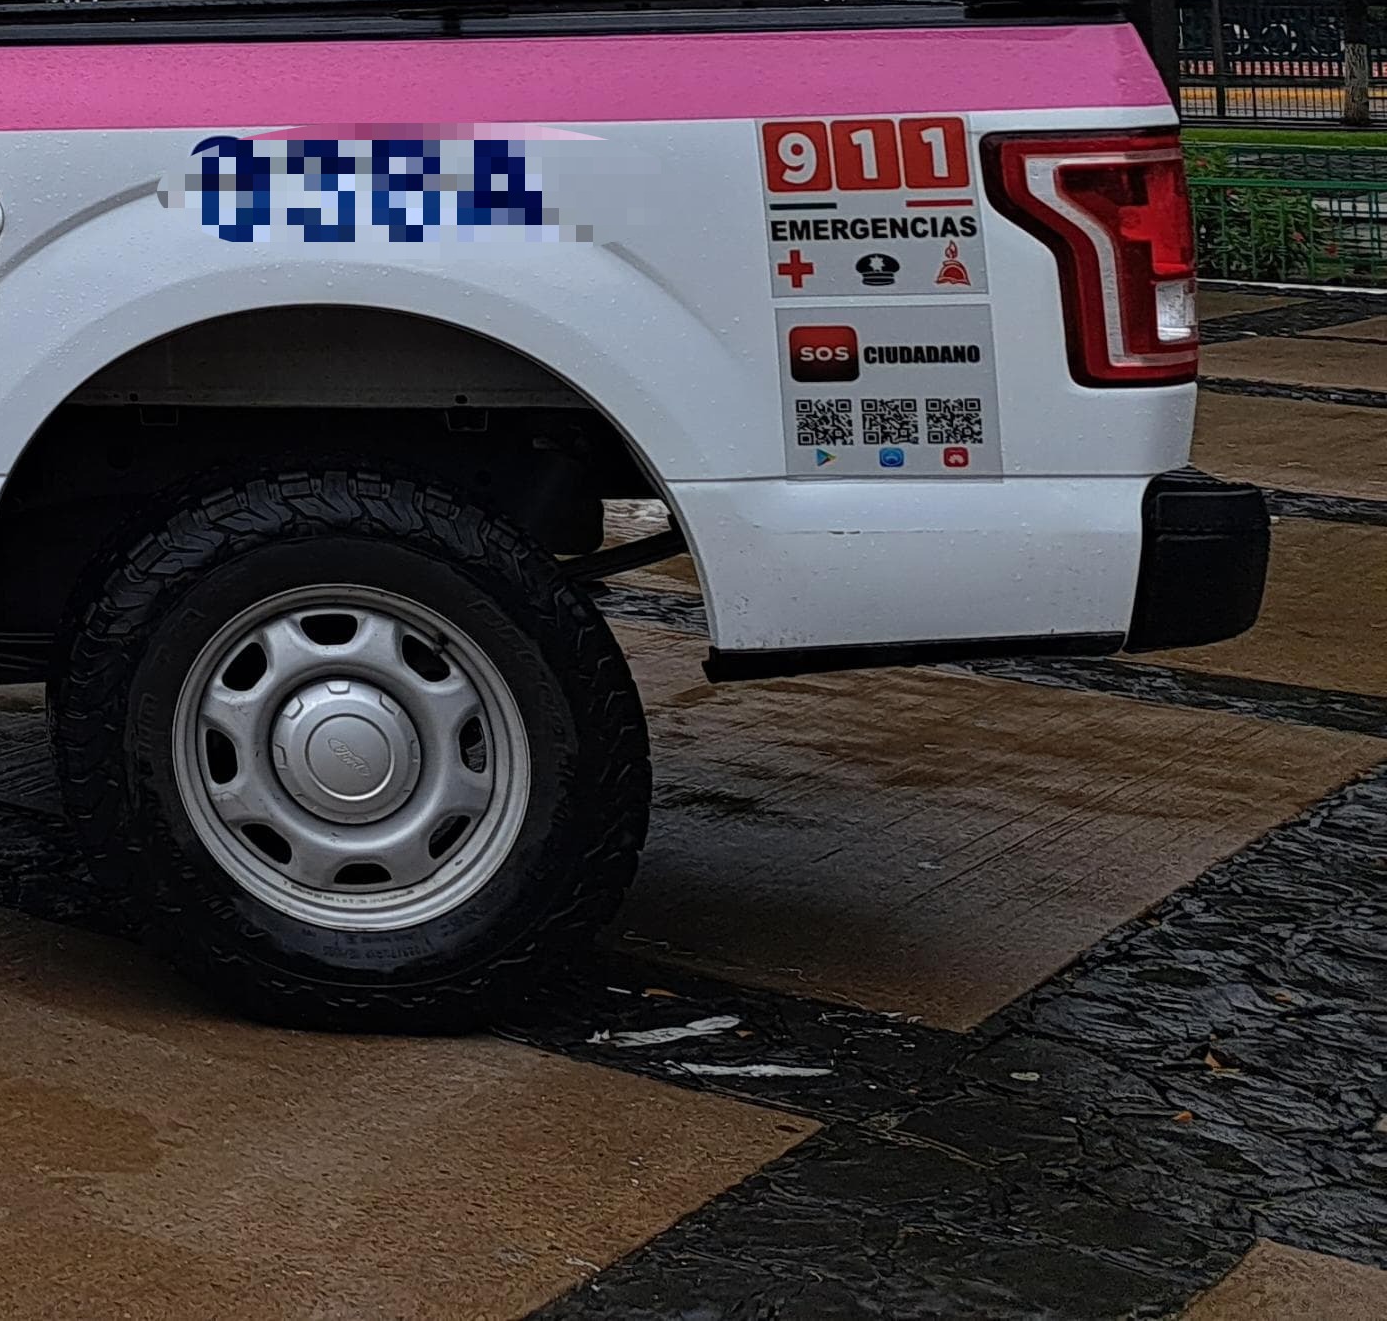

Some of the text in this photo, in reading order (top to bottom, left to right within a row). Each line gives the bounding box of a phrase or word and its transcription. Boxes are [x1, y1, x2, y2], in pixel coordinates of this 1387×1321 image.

[771, 215, 978, 242] EMERGENCIAS
[799, 343, 981, 365] SOS CIUDADANO
